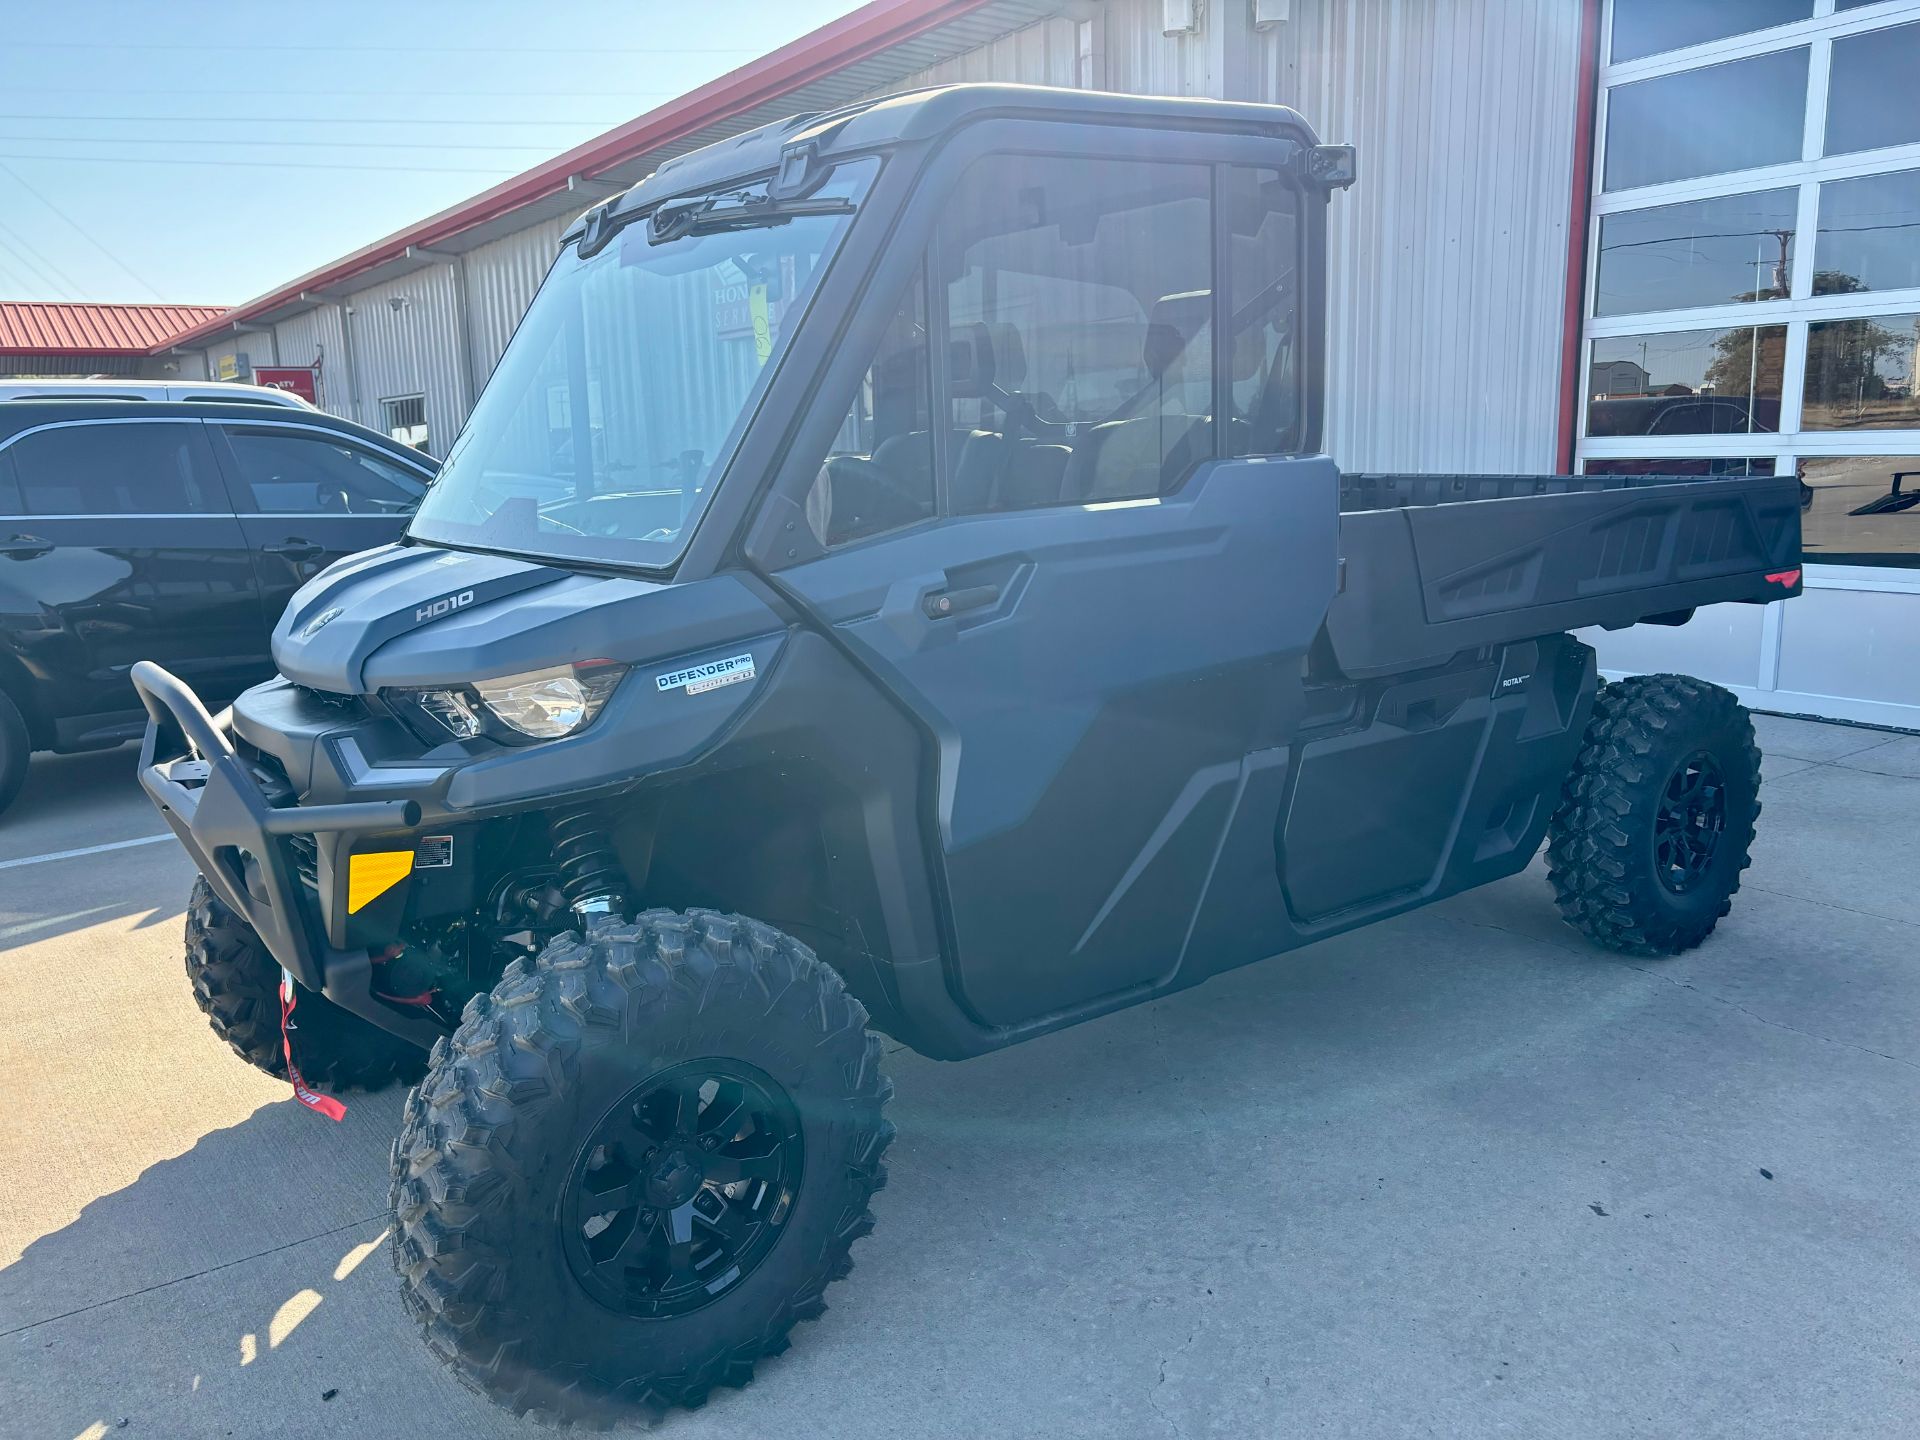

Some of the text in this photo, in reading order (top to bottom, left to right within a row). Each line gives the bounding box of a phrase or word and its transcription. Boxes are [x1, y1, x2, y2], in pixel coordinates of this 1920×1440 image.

[416, 590, 474, 622] HD10
[658, 661, 734, 687] DEFENDER
[735, 656, 751, 666] PRO
[1503, 677, 1523, 687] ROTAX
